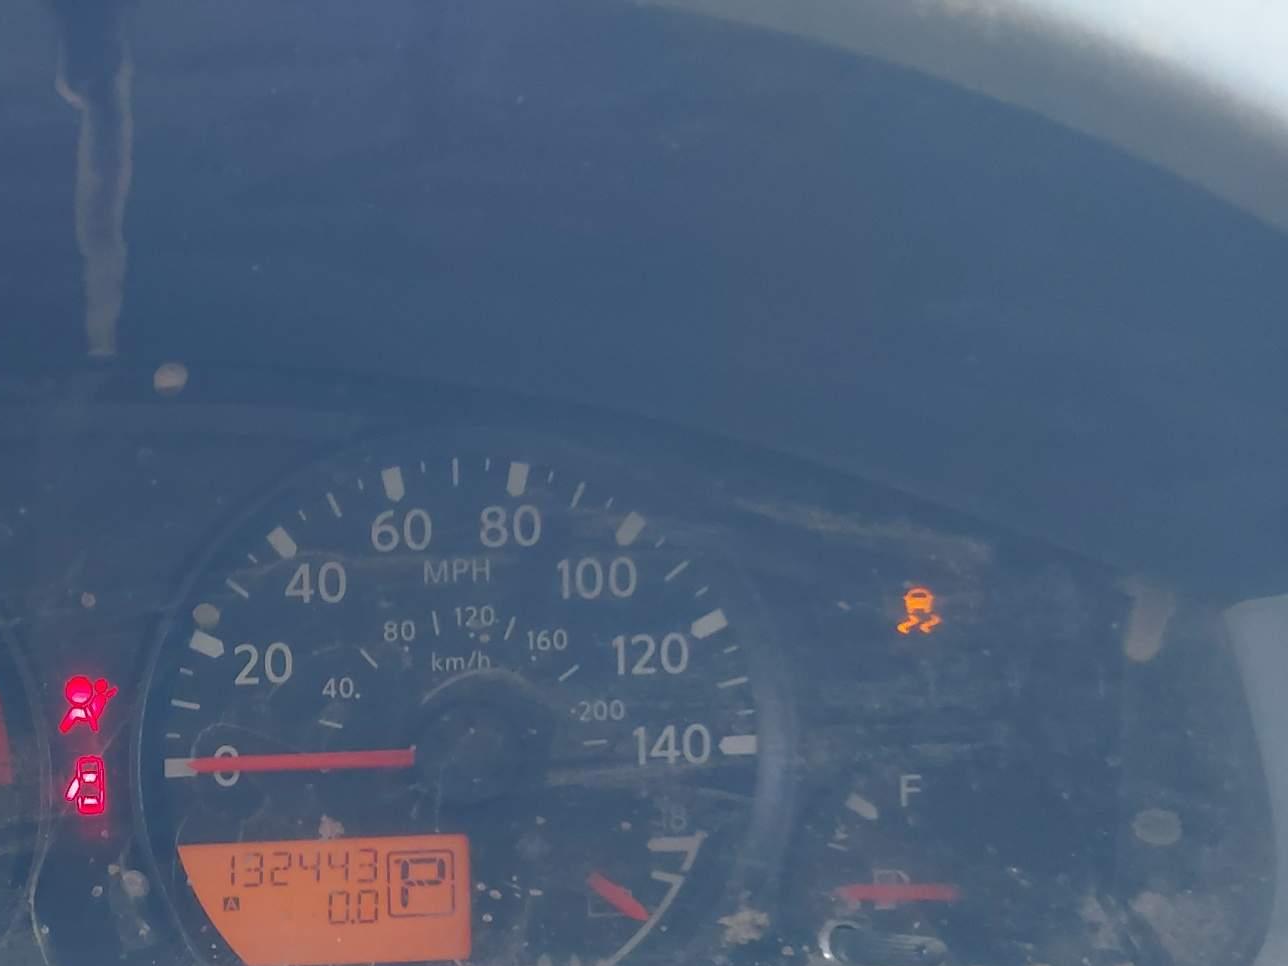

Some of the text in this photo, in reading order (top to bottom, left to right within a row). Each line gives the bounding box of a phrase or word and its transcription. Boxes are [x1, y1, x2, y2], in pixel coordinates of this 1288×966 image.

[371, 509, 431, 551] 60
[479, 505, 541, 548] 80
[285, 561, 346, 603] 40
[423, 558, 491, 584] MPH
[557, 557, 637, 599] 100
[383, 620, 415, 642] 80
[455, 606, 495, 626] 120
[527, 629, 567, 650] 160
[613, 633, 689, 675] 120
[233, 642, 292, 686] 20
[431, 651, 490, 673] km/h
[578, 700, 624, 721] 200
[632, 723, 709, 765] 140
[214, 745, 240, 787] 0
[900, 774, 922, 807] F
[230, 848, 378, 888] 132443
[394, 857, 446, 909] P
[328, 889, 379, 925] 0.0
